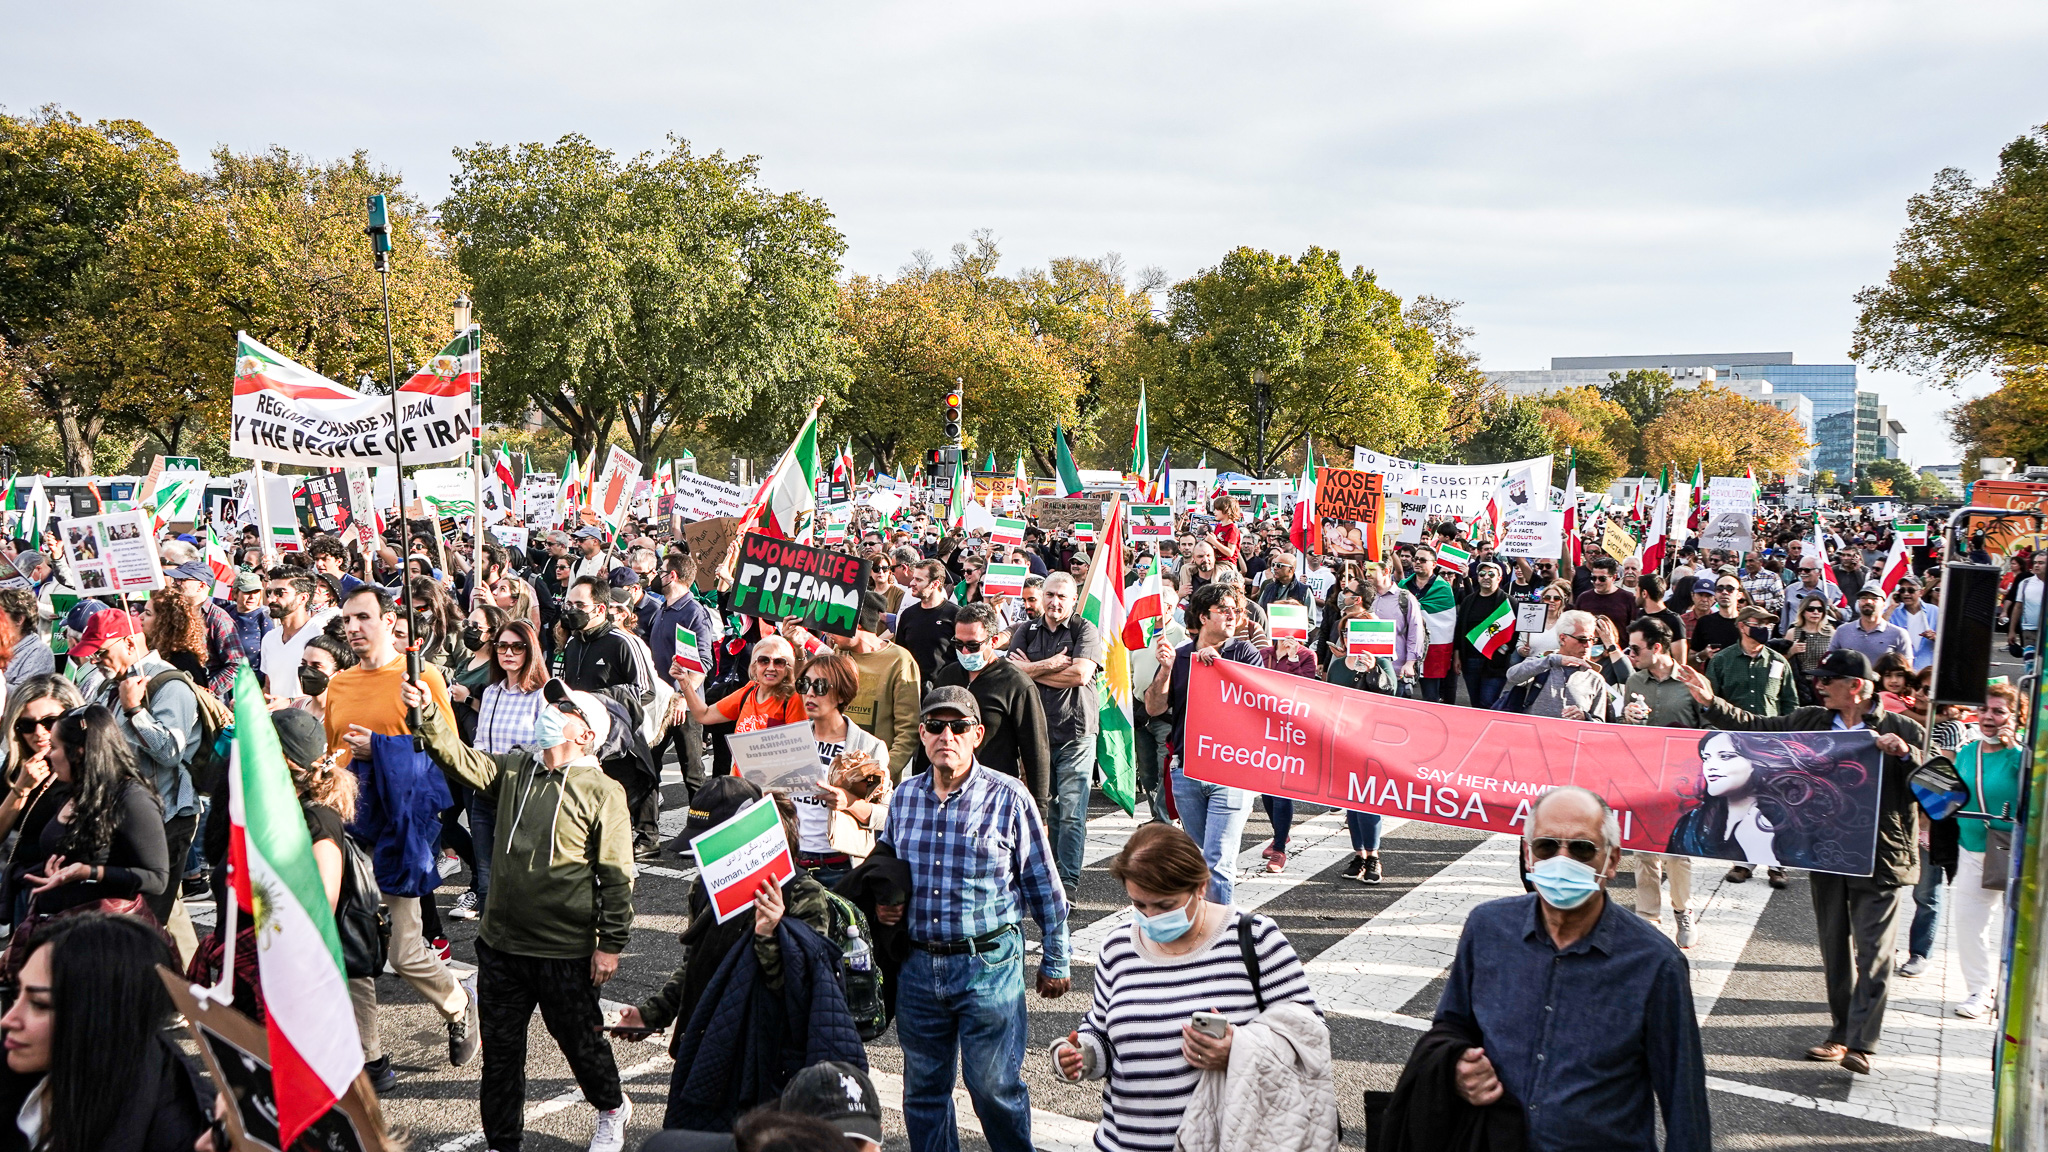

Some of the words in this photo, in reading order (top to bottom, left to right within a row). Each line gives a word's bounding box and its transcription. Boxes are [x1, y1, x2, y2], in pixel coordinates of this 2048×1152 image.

[256, 394, 316, 428] REGIME
[317, 417, 379, 438] CHANGE
[402, 397, 435, 424] IRAN
[250, 418, 289, 452] THE
[292, 429, 382, 458] PEOPLE
[385, 426, 419, 454] OF
[614, 450, 636, 470] WOMAN
[1359, 452, 1376, 464] TO
[306, 480, 328, 495] THERE
[326, 476, 337, 490] IS
[680, 474, 691, 483] We
[692, 478, 702, 486] Are
[702, 480, 724, 493] Already
[724, 486, 741, 498] Dead
[1325, 470, 1376, 492] KOSE
[1712, 478, 1730, 487] IRAN
[678, 488, 694, 498] When
[694, 488, 705, 496] We
[701, 496, 718, 506] Keep
[718, 497, 740, 509] Silence
[1322, 486, 1381, 510] NANAT
[1712, 490, 1751, 498] REVOLUTION
[314, 506, 325, 520] BE
[673, 502, 689, 513] Over
[692, 508, 716, 519] Murder
[1042, 502, 1066, 510] IRANIAN
[1314, 502, 1377, 524] KHAMENEI
[1606, 526, 1622, 544] DOWN
[2009, 517, 2034, 536] ICE
[734, 562, 860, 630] FREEDOM
[1220, 680, 1310, 718] Woman
[1264, 717, 1306, 746] Life
[1198, 735, 1306, 776] Freedom
[1416, 766, 1453, 784] SAY
[1457, 772, 1501, 790] HER
[1347, 772, 1488, 824] MAHSA
[710, 868, 746, 890] Woman,
[745, 858, 762, 872] Life,
[761, 839, 786, 861] Freedom
